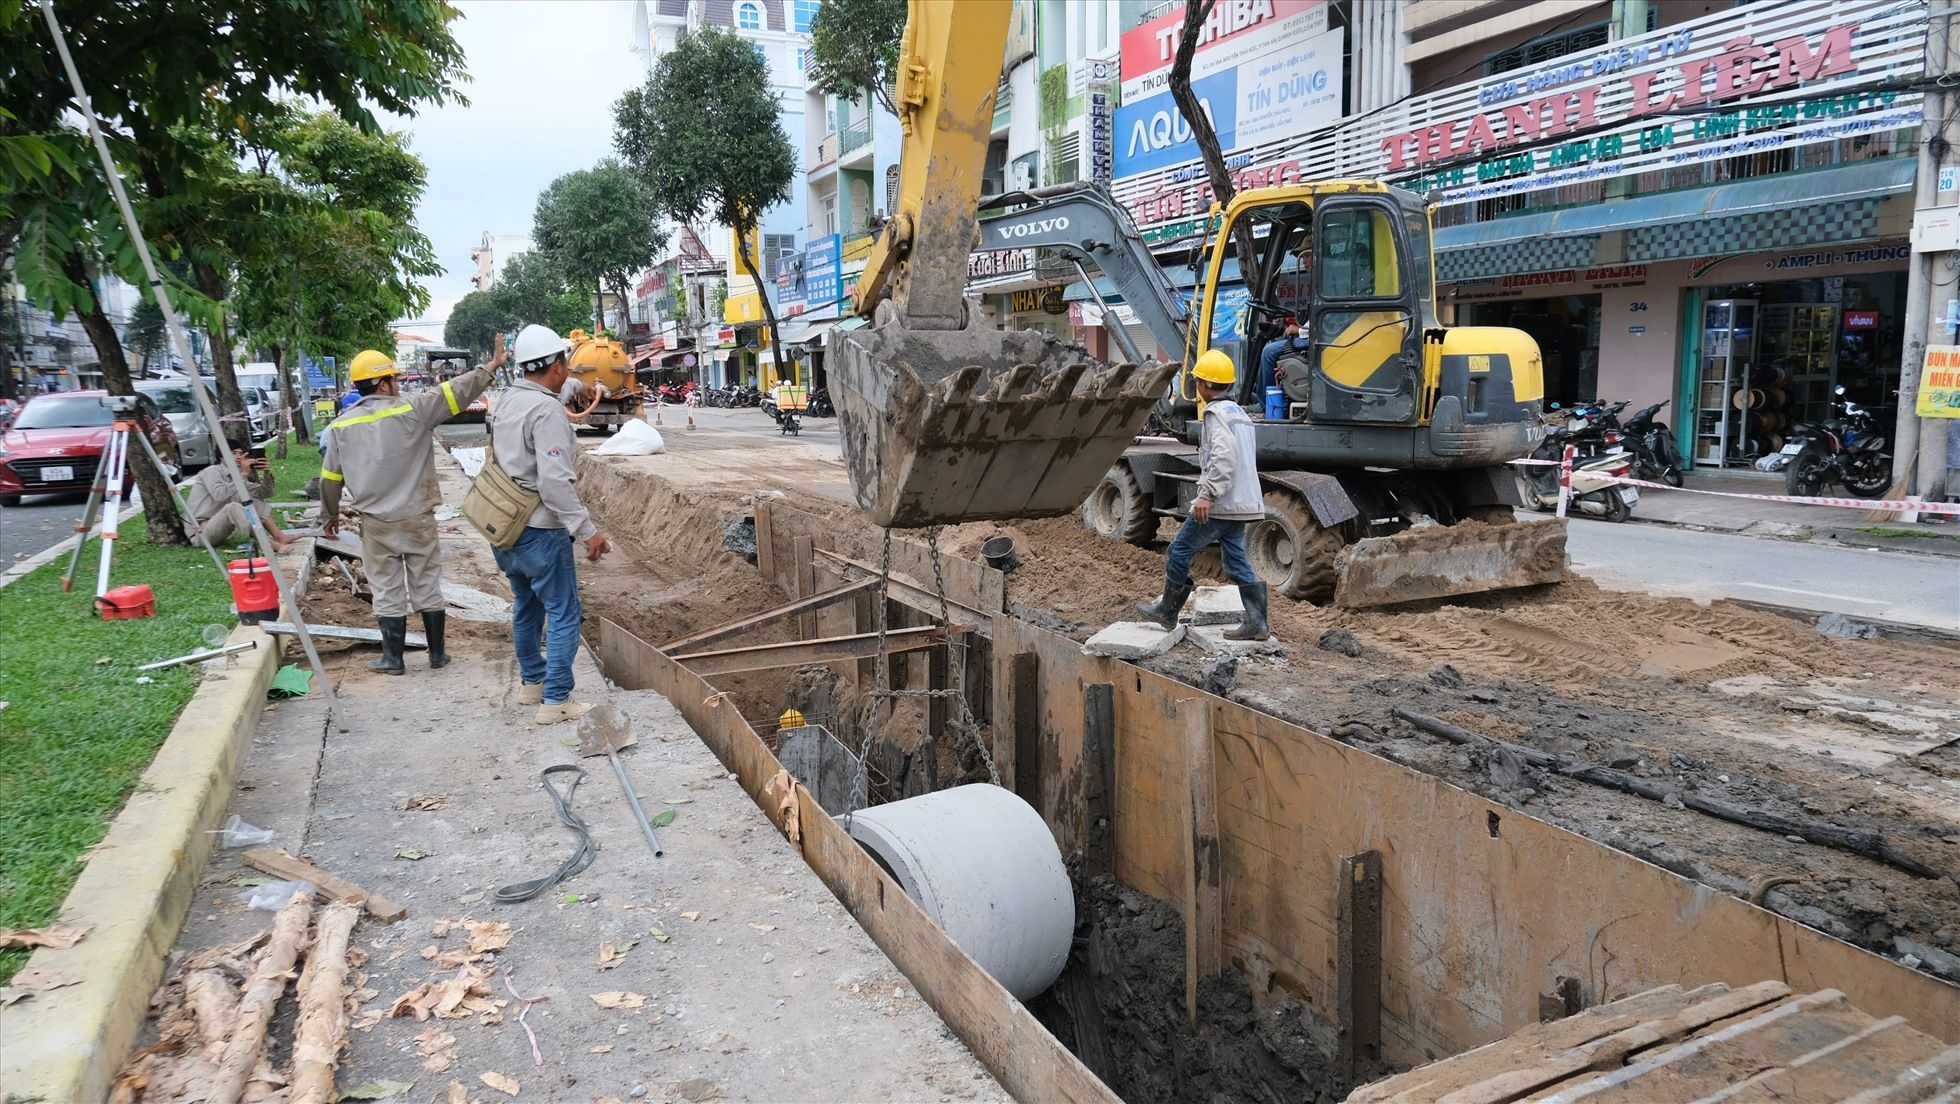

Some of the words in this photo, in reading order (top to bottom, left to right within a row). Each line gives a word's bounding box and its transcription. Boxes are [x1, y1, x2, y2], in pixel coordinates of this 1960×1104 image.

[1155, 0, 1275, 61] TOHIBA
[1526, 64, 1585, 91] HÀNG
[1247, 82, 1272, 113] TÍN
[1278, 69, 1328, 104] DŨNG
[1380, 86, 1602, 172] THANH
[1627, 23, 1861, 114] LIÊM
[1640, 123, 1674, 150] LOA
[998, 217, 1070, 239] VOLVO
[1777, 252, 1832, 270] AMPLI
[1844, 244, 1912, 264] THÙNG
[1630, 302, 1648, 312] 34
[1927, 349, 1947, 367] BÚN
[1929, 369, 1953, 387] MIẾN
